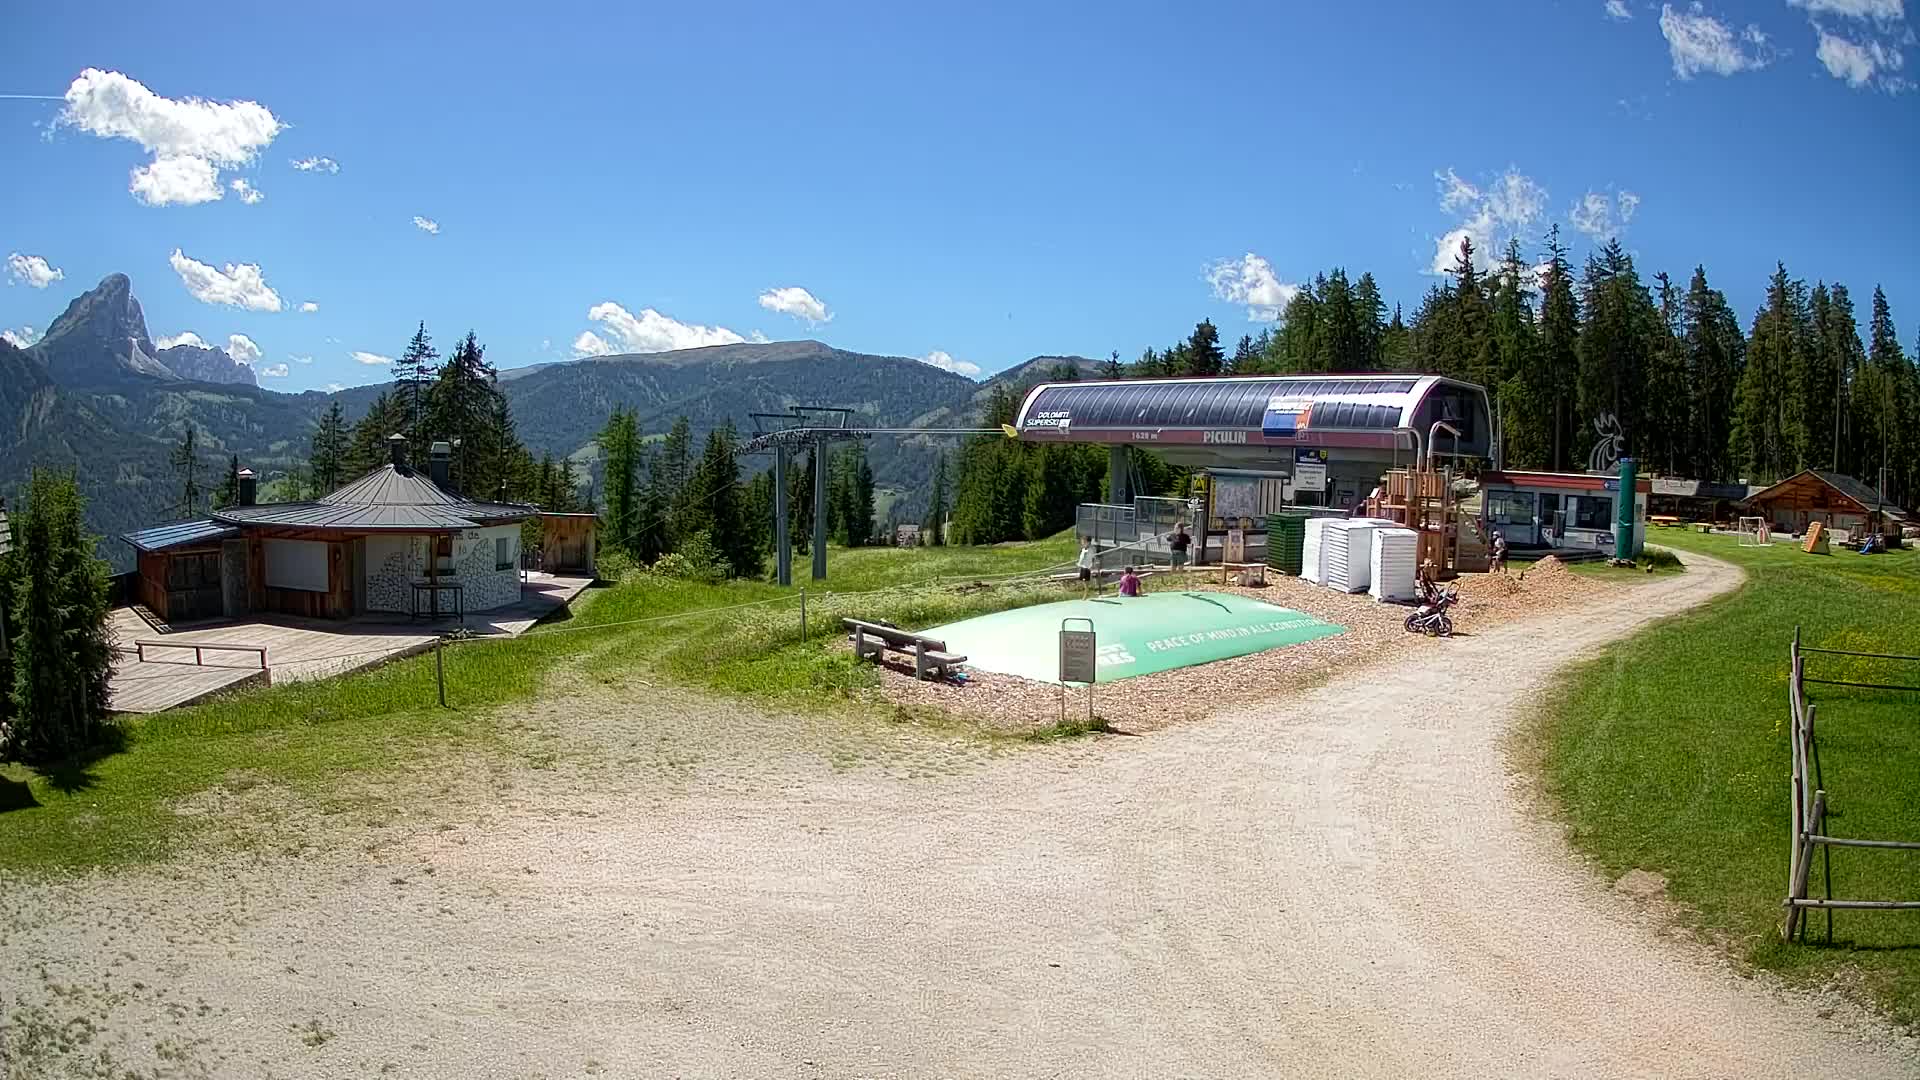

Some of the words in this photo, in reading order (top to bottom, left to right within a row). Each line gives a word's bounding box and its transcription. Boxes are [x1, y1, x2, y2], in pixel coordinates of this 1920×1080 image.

[1203, 431, 1246, 444] PICULIN
[1145, 636, 1191, 652] PEACE
[1190, 632, 1205, 644] OF
[1206, 628, 1237, 641] MIND
[1235, 627, 1251, 637] IN
[1249, 624, 1272, 635] ALL
